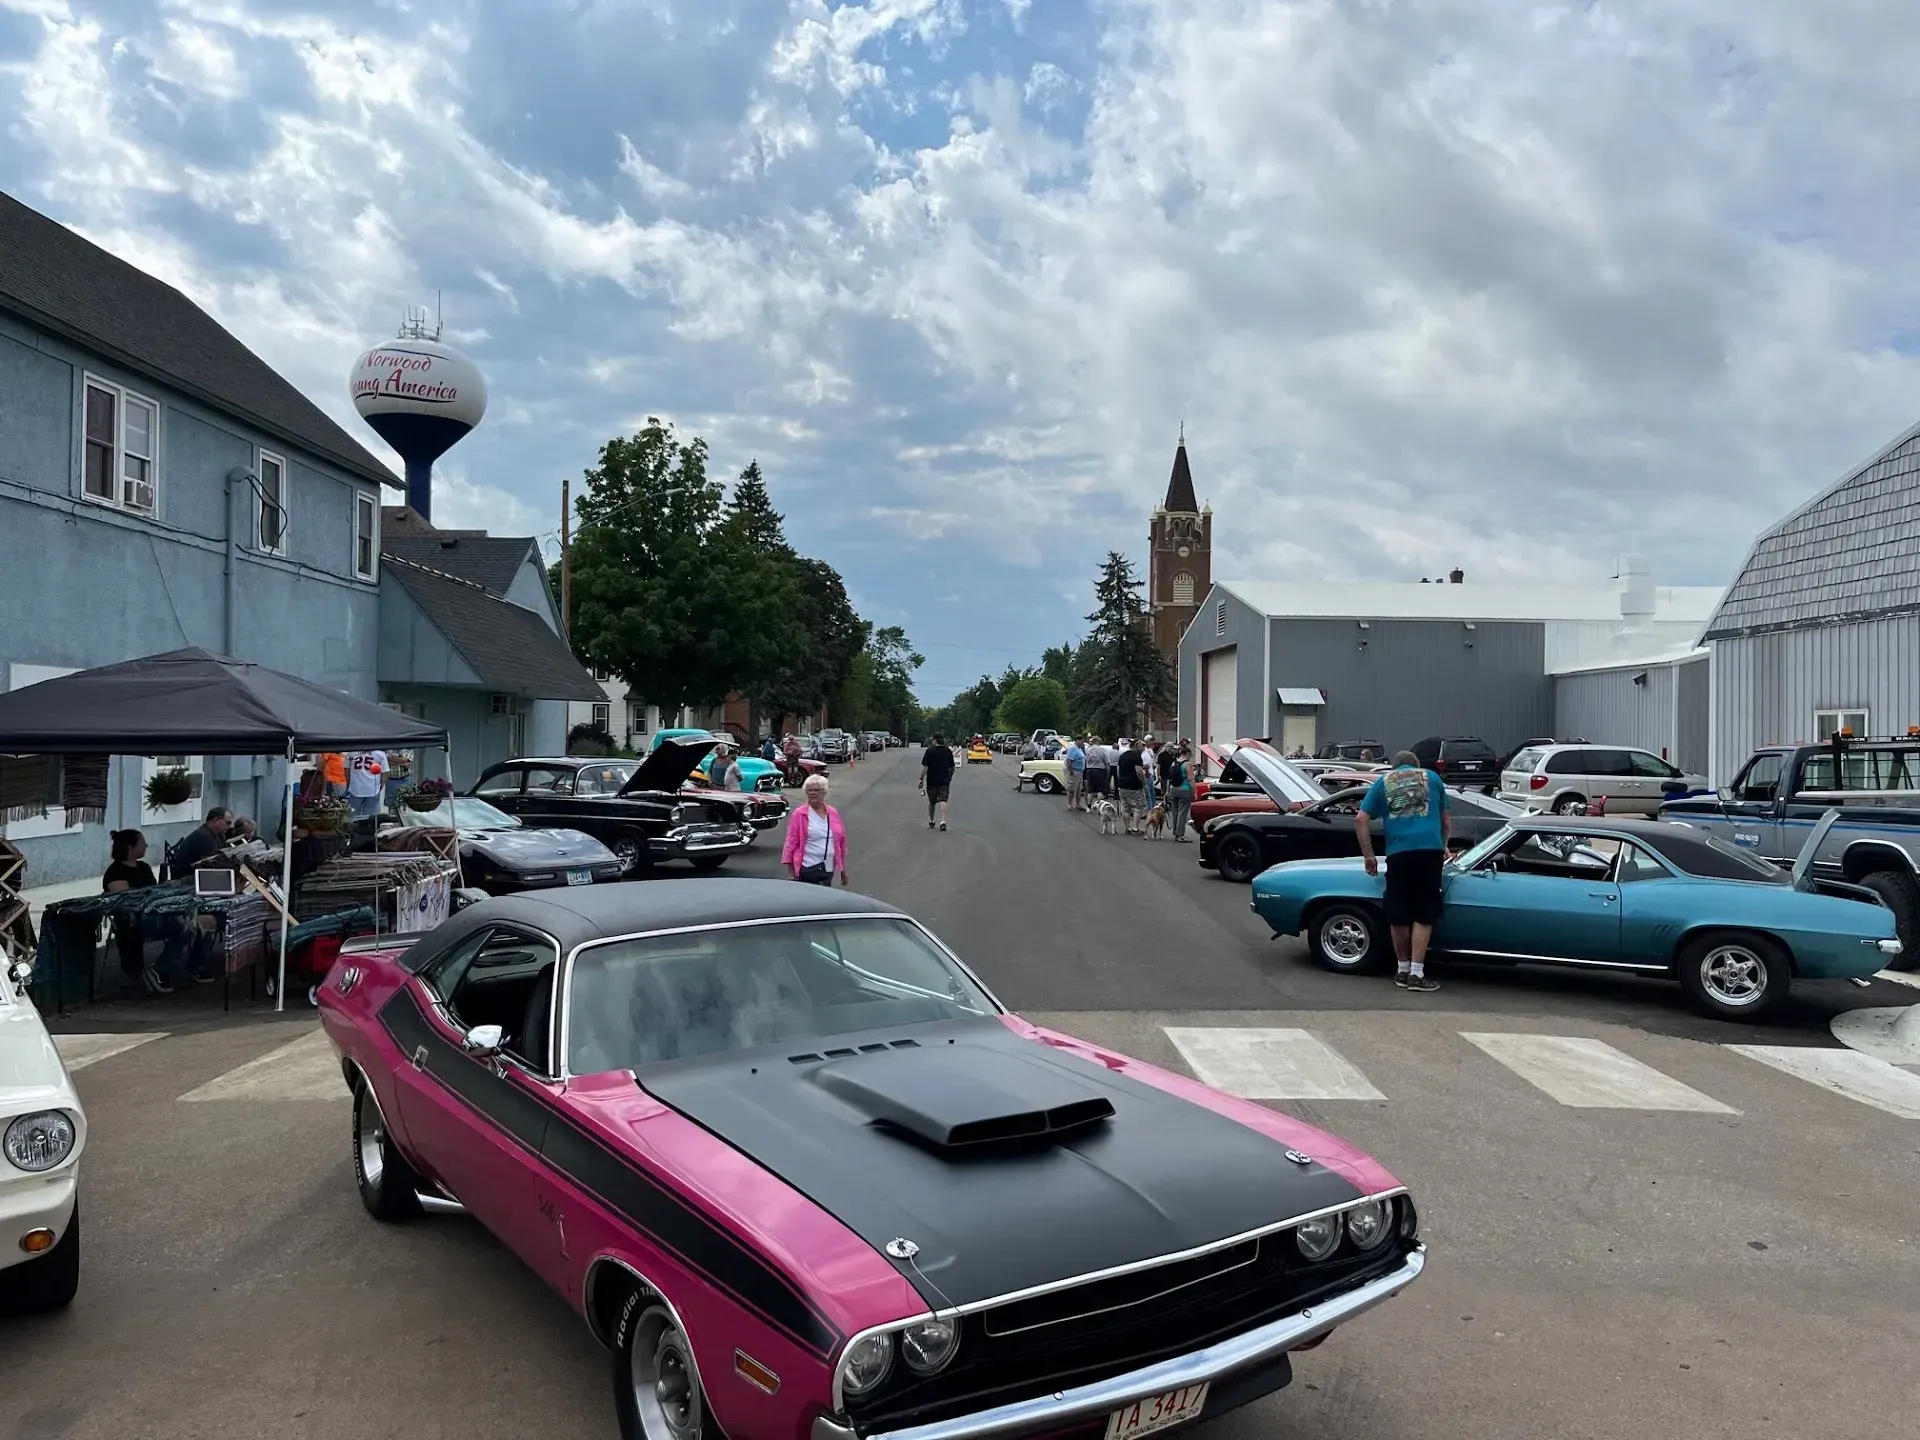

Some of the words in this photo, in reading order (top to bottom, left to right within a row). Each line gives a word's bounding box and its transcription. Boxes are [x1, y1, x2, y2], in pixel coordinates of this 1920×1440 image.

[361, 349, 432, 371] Norwood
[353, 378, 380, 400] oung
[385, 368, 458, 400] America
[354, 756, 374, 770] 25
[617, 1291, 639, 1348] Radial
